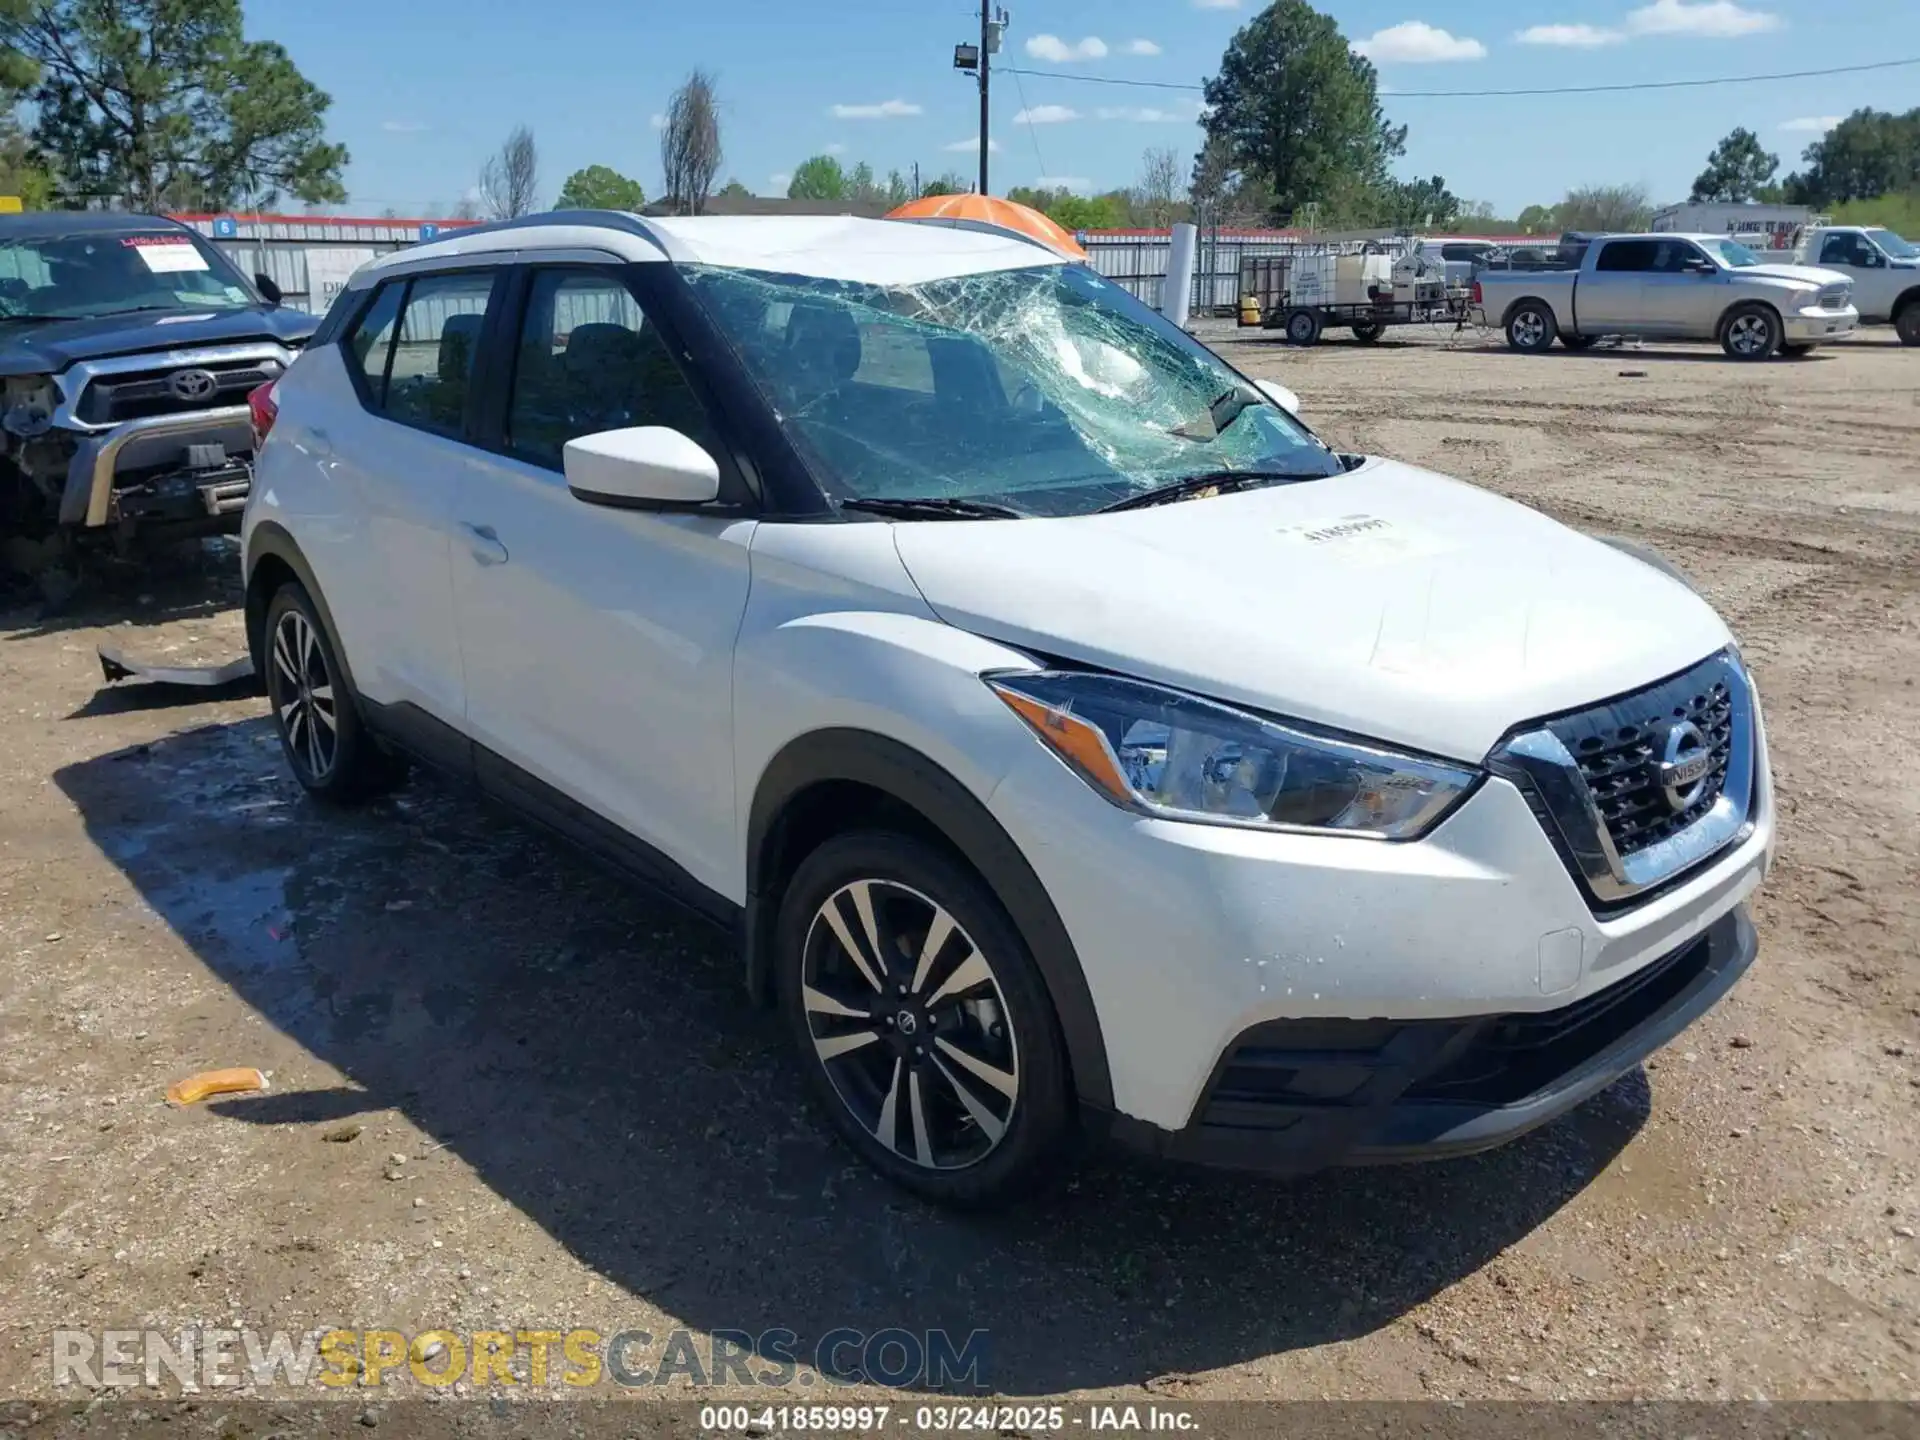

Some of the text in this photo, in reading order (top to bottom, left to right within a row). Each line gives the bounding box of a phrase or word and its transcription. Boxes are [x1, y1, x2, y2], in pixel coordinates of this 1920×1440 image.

[220, 221, 230, 234] 6
[425, 226, 433, 239] 7
[1672, 758, 1708, 782] NISS
